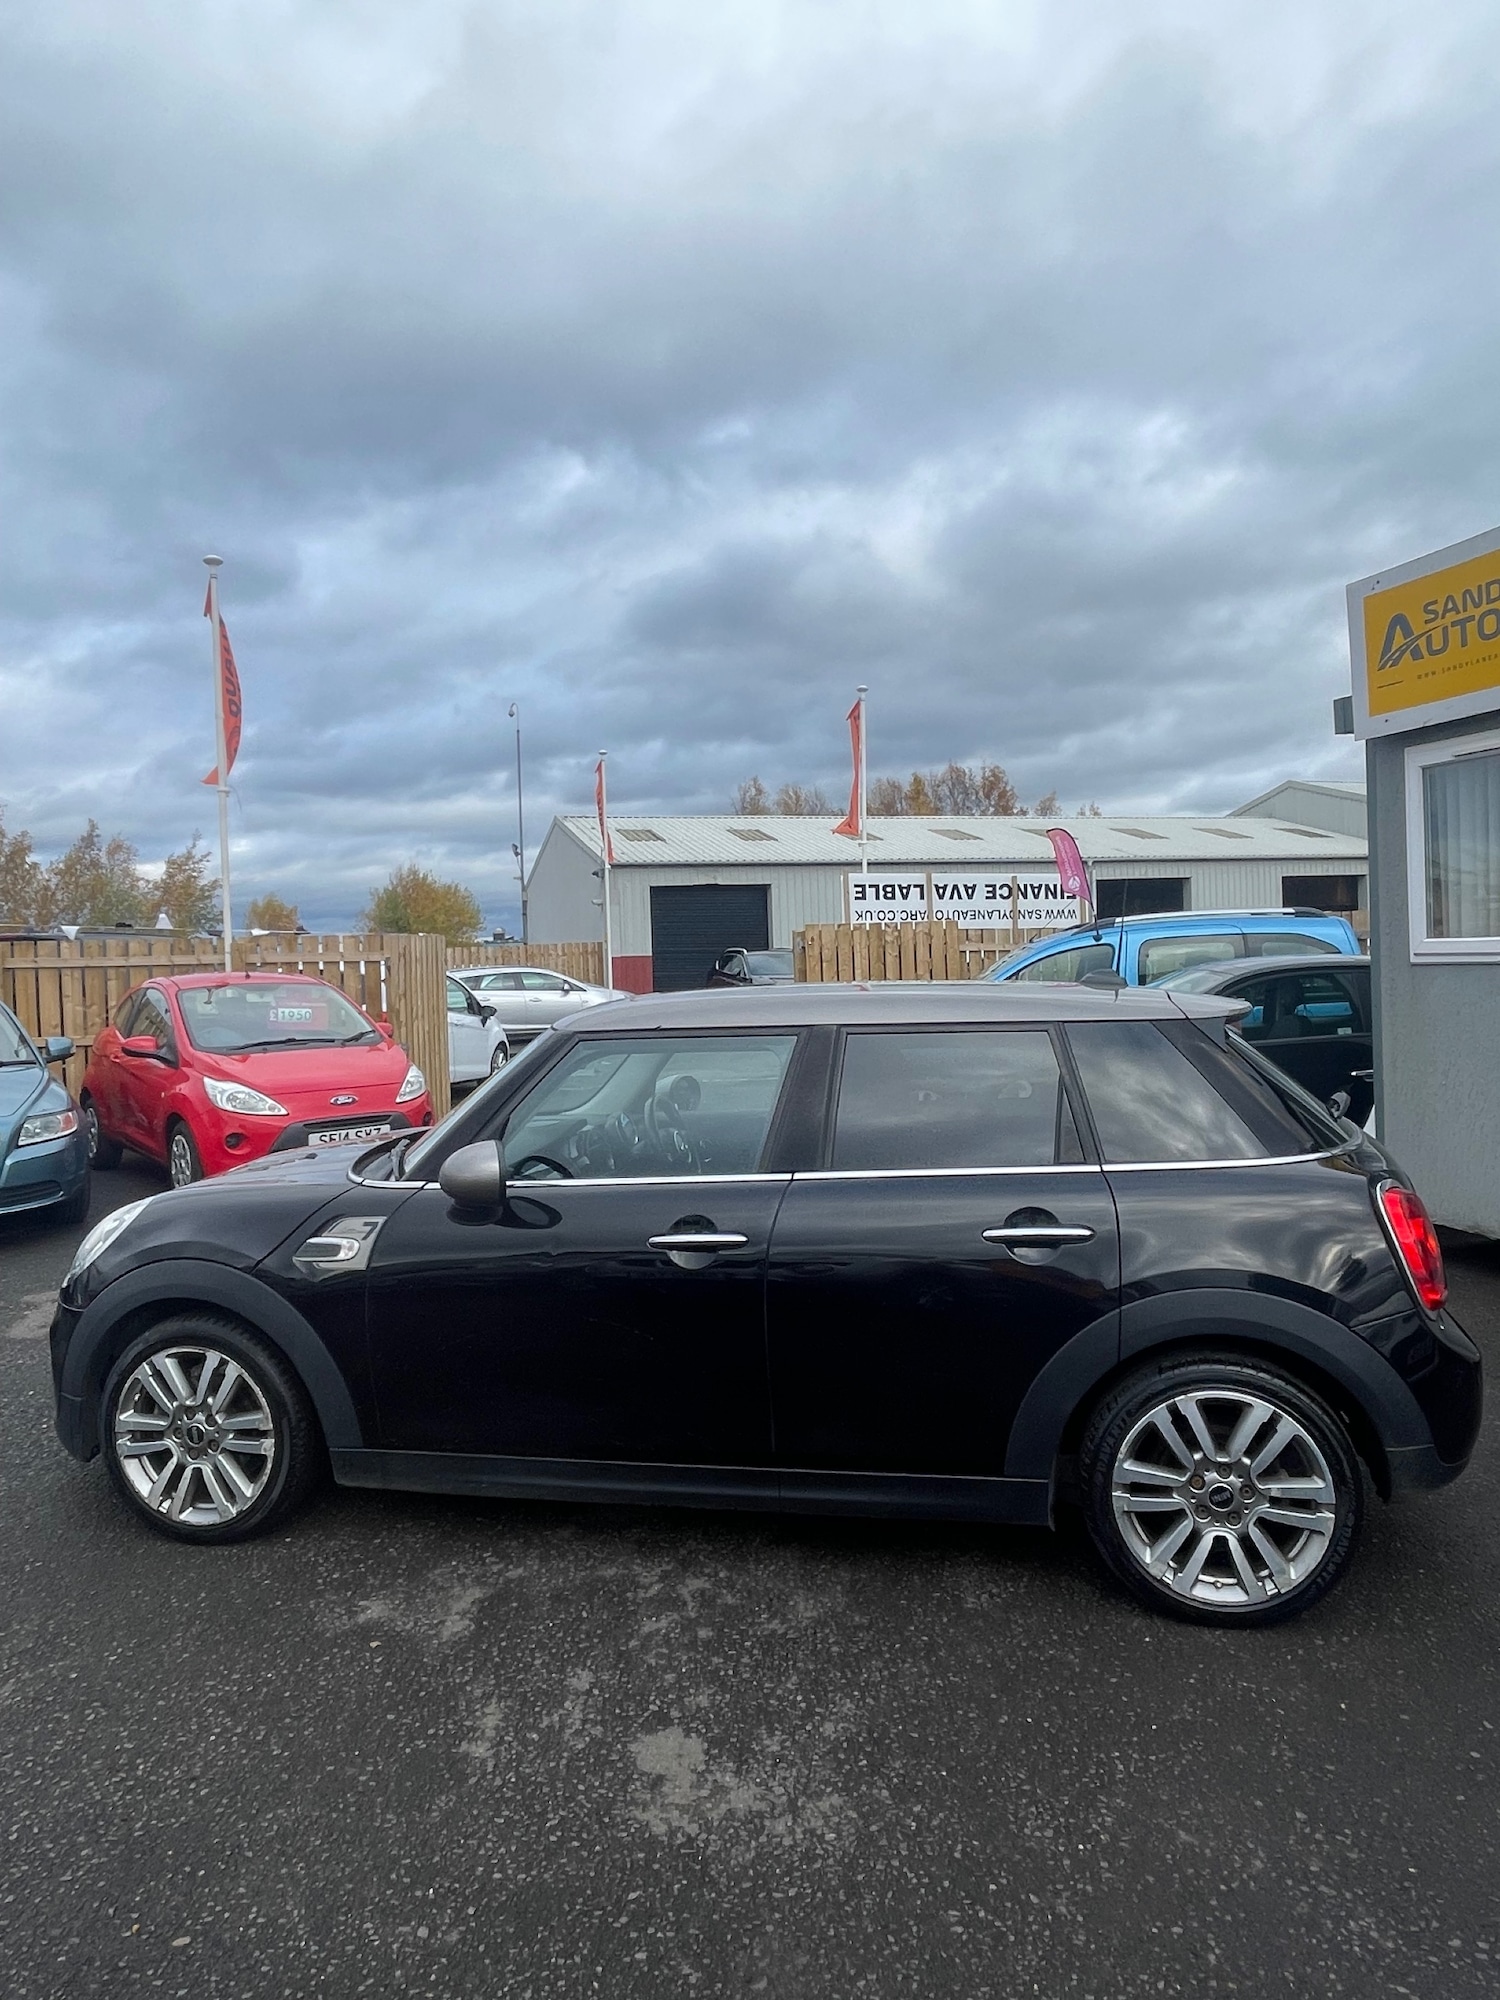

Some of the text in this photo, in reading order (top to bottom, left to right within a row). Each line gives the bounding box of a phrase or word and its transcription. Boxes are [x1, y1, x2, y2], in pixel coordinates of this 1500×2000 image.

[1423, 579, 1500, 625] SAND
[1377, 608, 1500, 672] AUTO
[363, 1222, 379, 1240] 7
